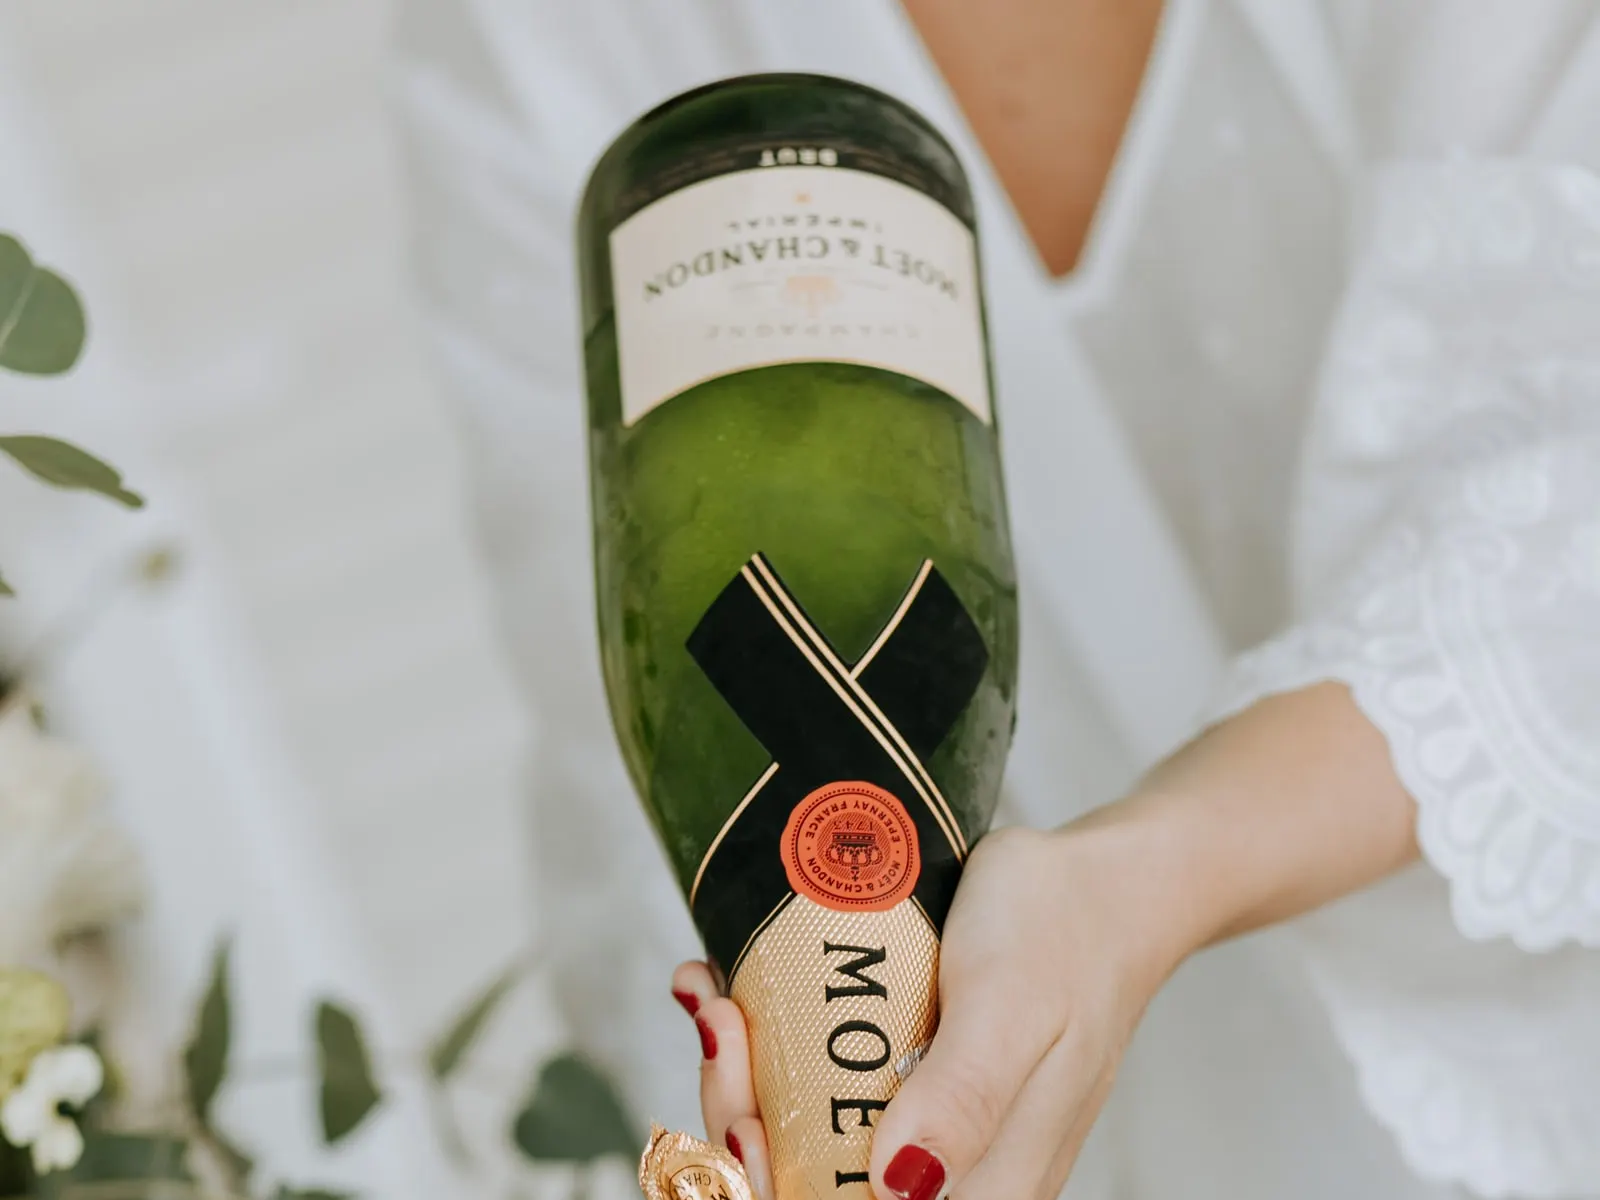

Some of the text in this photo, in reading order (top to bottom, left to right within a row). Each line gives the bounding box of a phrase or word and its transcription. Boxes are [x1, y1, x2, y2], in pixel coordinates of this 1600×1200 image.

[758, 146, 838, 167] BRUT
[840, 237, 859, 257] &
[643, 235, 831, 302] CHANDON
[805, 799, 848, 839] FRANCE
[832, 820, 874, 832] 1743
[807, 857, 862, 893] CHANDON
[866, 881, 874, 891] &
